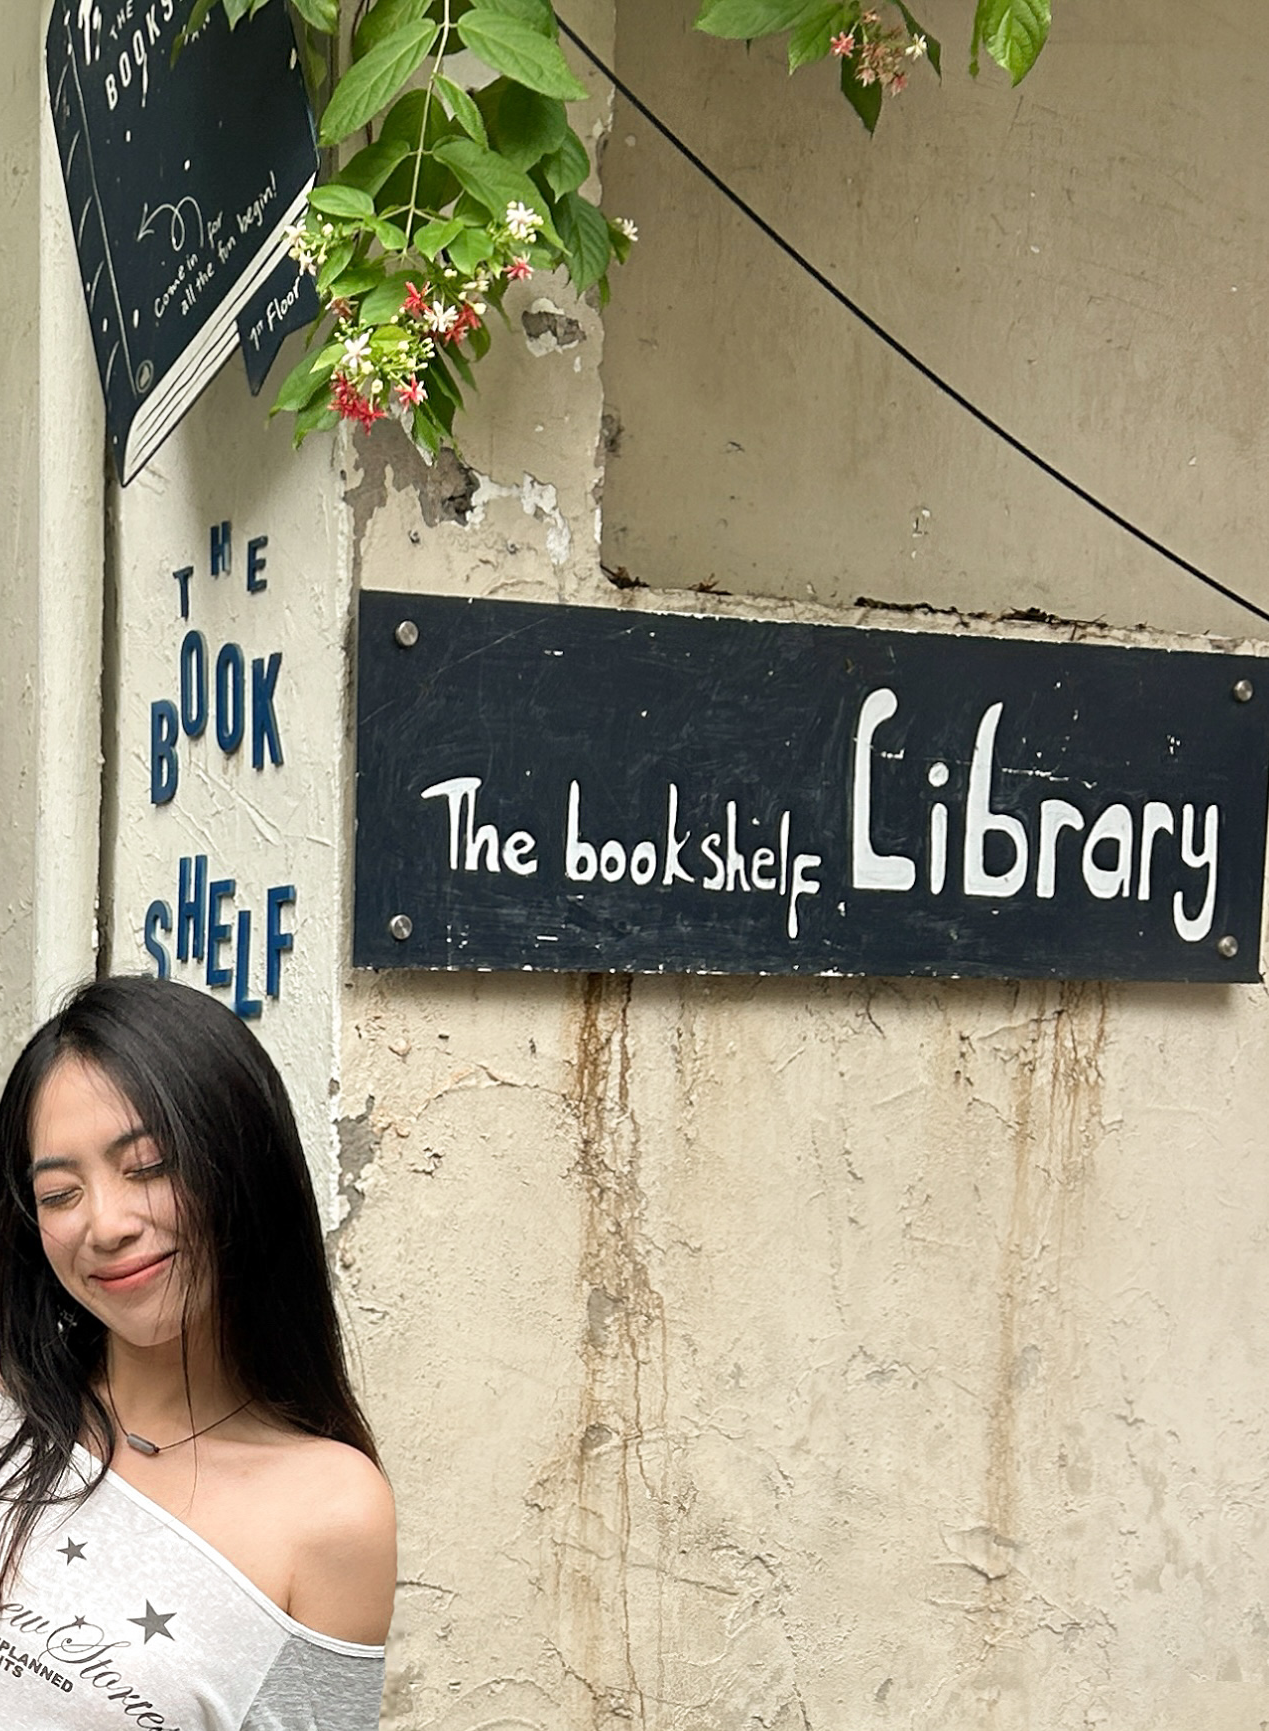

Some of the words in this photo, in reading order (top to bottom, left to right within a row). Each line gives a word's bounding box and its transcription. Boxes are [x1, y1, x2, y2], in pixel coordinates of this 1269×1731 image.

[154, 264, 186, 318] Come
[186, 253, 199, 271] in
[207, 211, 223, 249] for
[181, 284, 197, 316] all
[195, 262, 215, 292] the
[217, 236, 236, 264] fun
[236, 170, 277, 234] begin!
[266, 276, 301, 332] Floor
[172, 520, 269, 622] THE
[150, 630, 285, 806] BOOK
[420, 776, 538, 877] The
[564, 778, 821, 940] bookshelf
[851, 687, 1220, 943] Library
[144, 854, 297, 1020] SHELF
